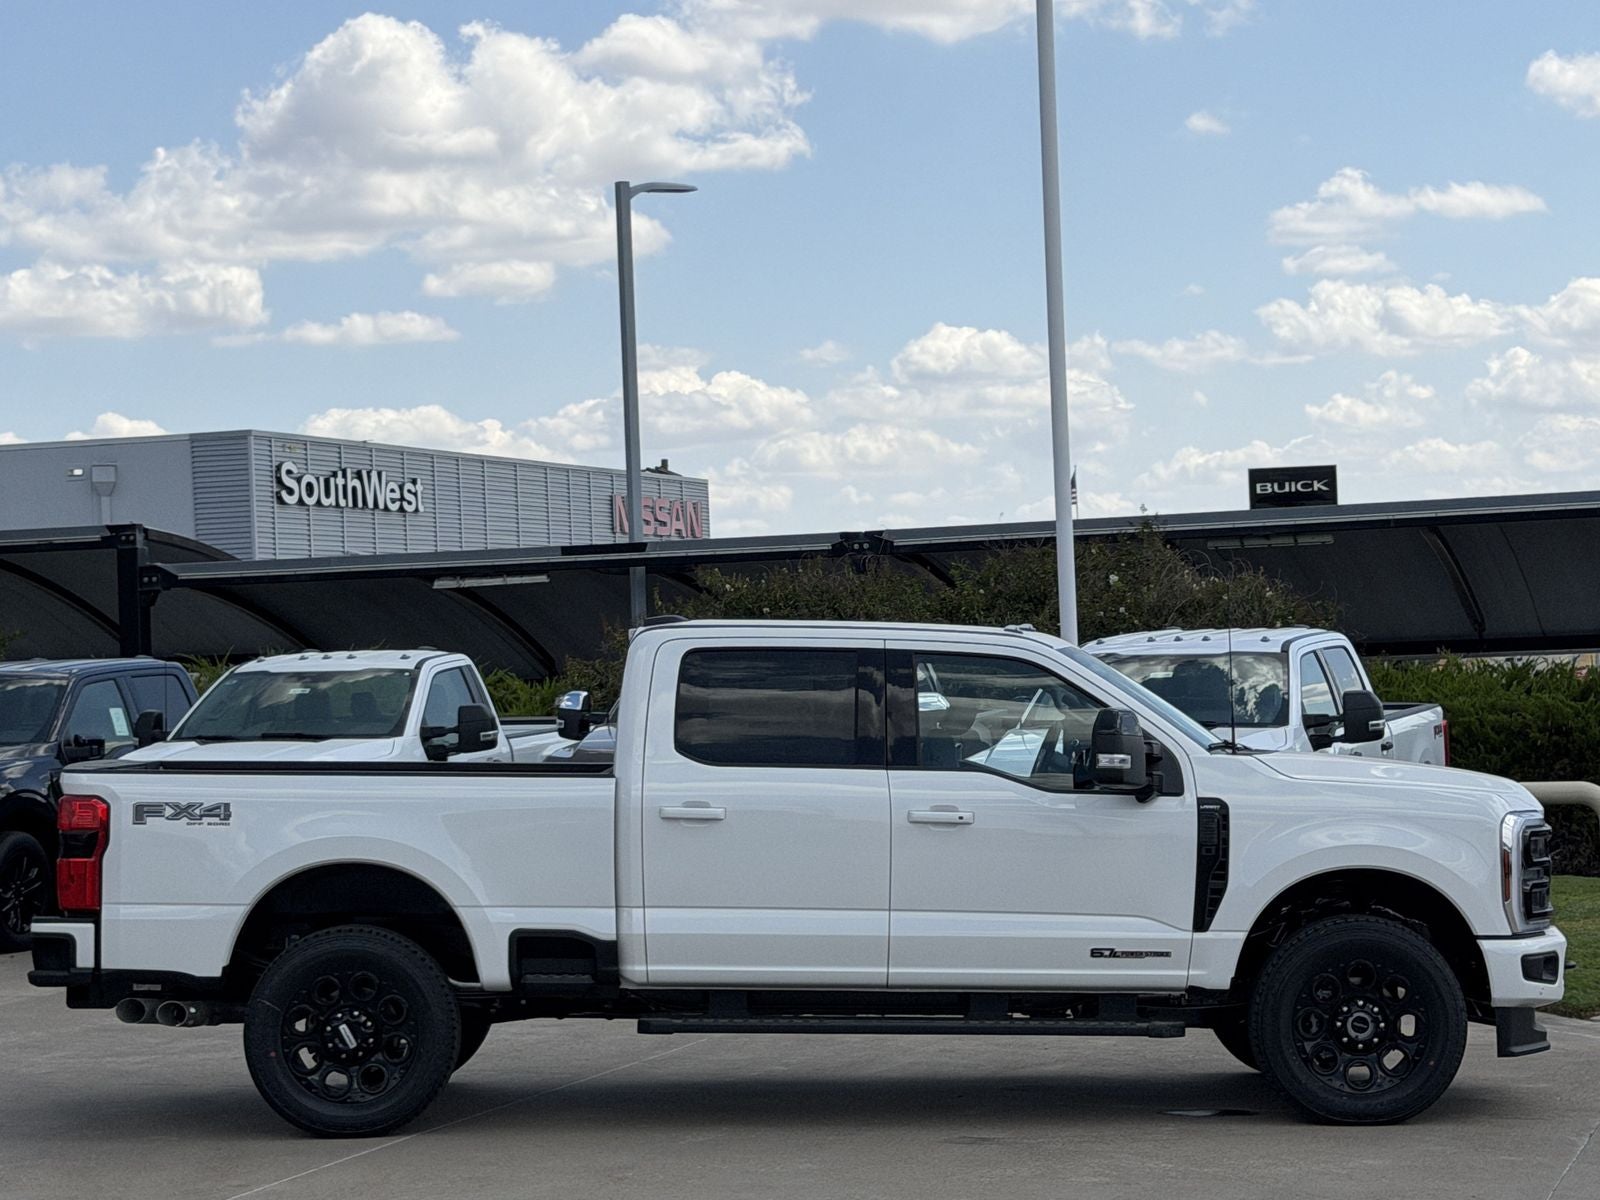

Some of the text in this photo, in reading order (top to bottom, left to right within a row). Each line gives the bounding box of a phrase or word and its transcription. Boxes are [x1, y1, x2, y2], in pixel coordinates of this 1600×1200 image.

[279, 460, 425, 513] SouthWest
[1256, 479, 1330, 494] BUICK
[613, 495, 703, 539] NSSAN
[132, 802, 232, 825] FX4
